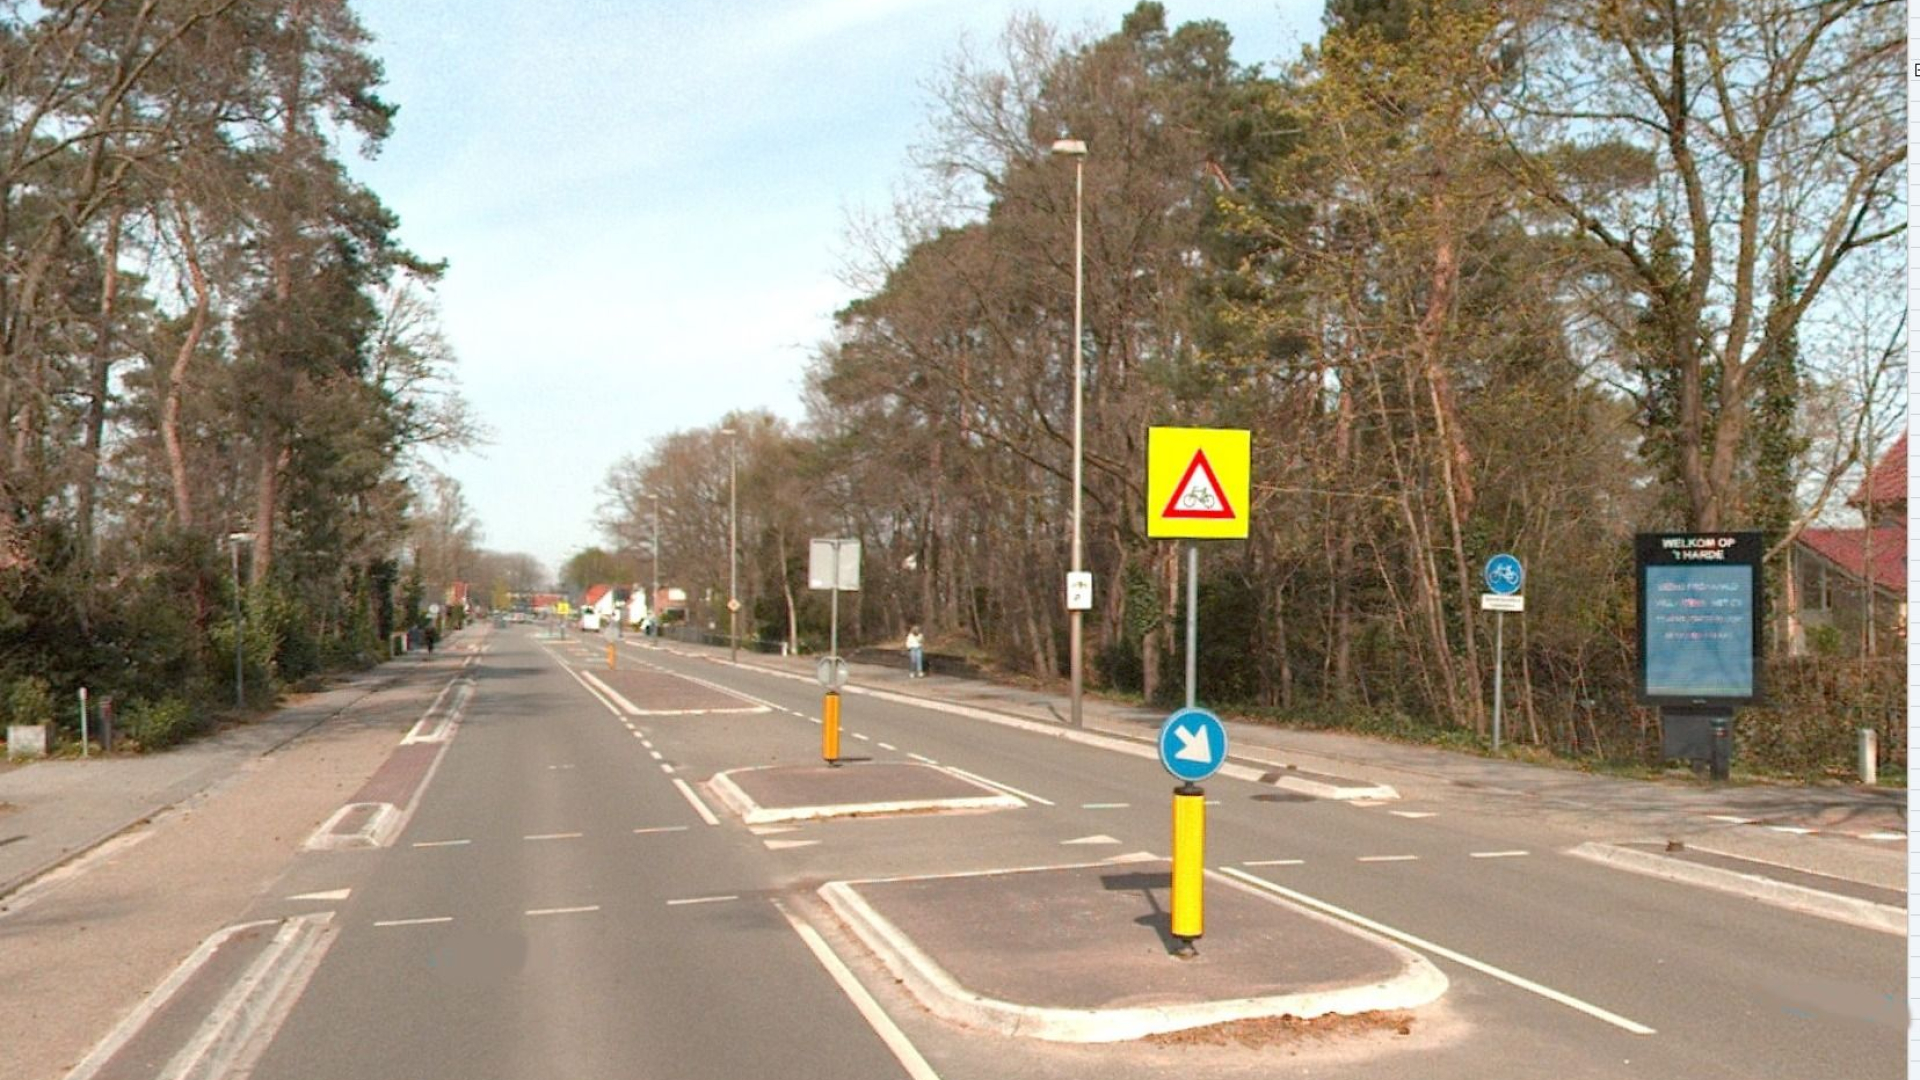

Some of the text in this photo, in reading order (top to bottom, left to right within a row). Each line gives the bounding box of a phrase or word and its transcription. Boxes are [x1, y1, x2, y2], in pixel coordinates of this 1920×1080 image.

[1662, 537, 1736, 548] WELKOM OP
[1682, 549, 1725, 560] HARDE
